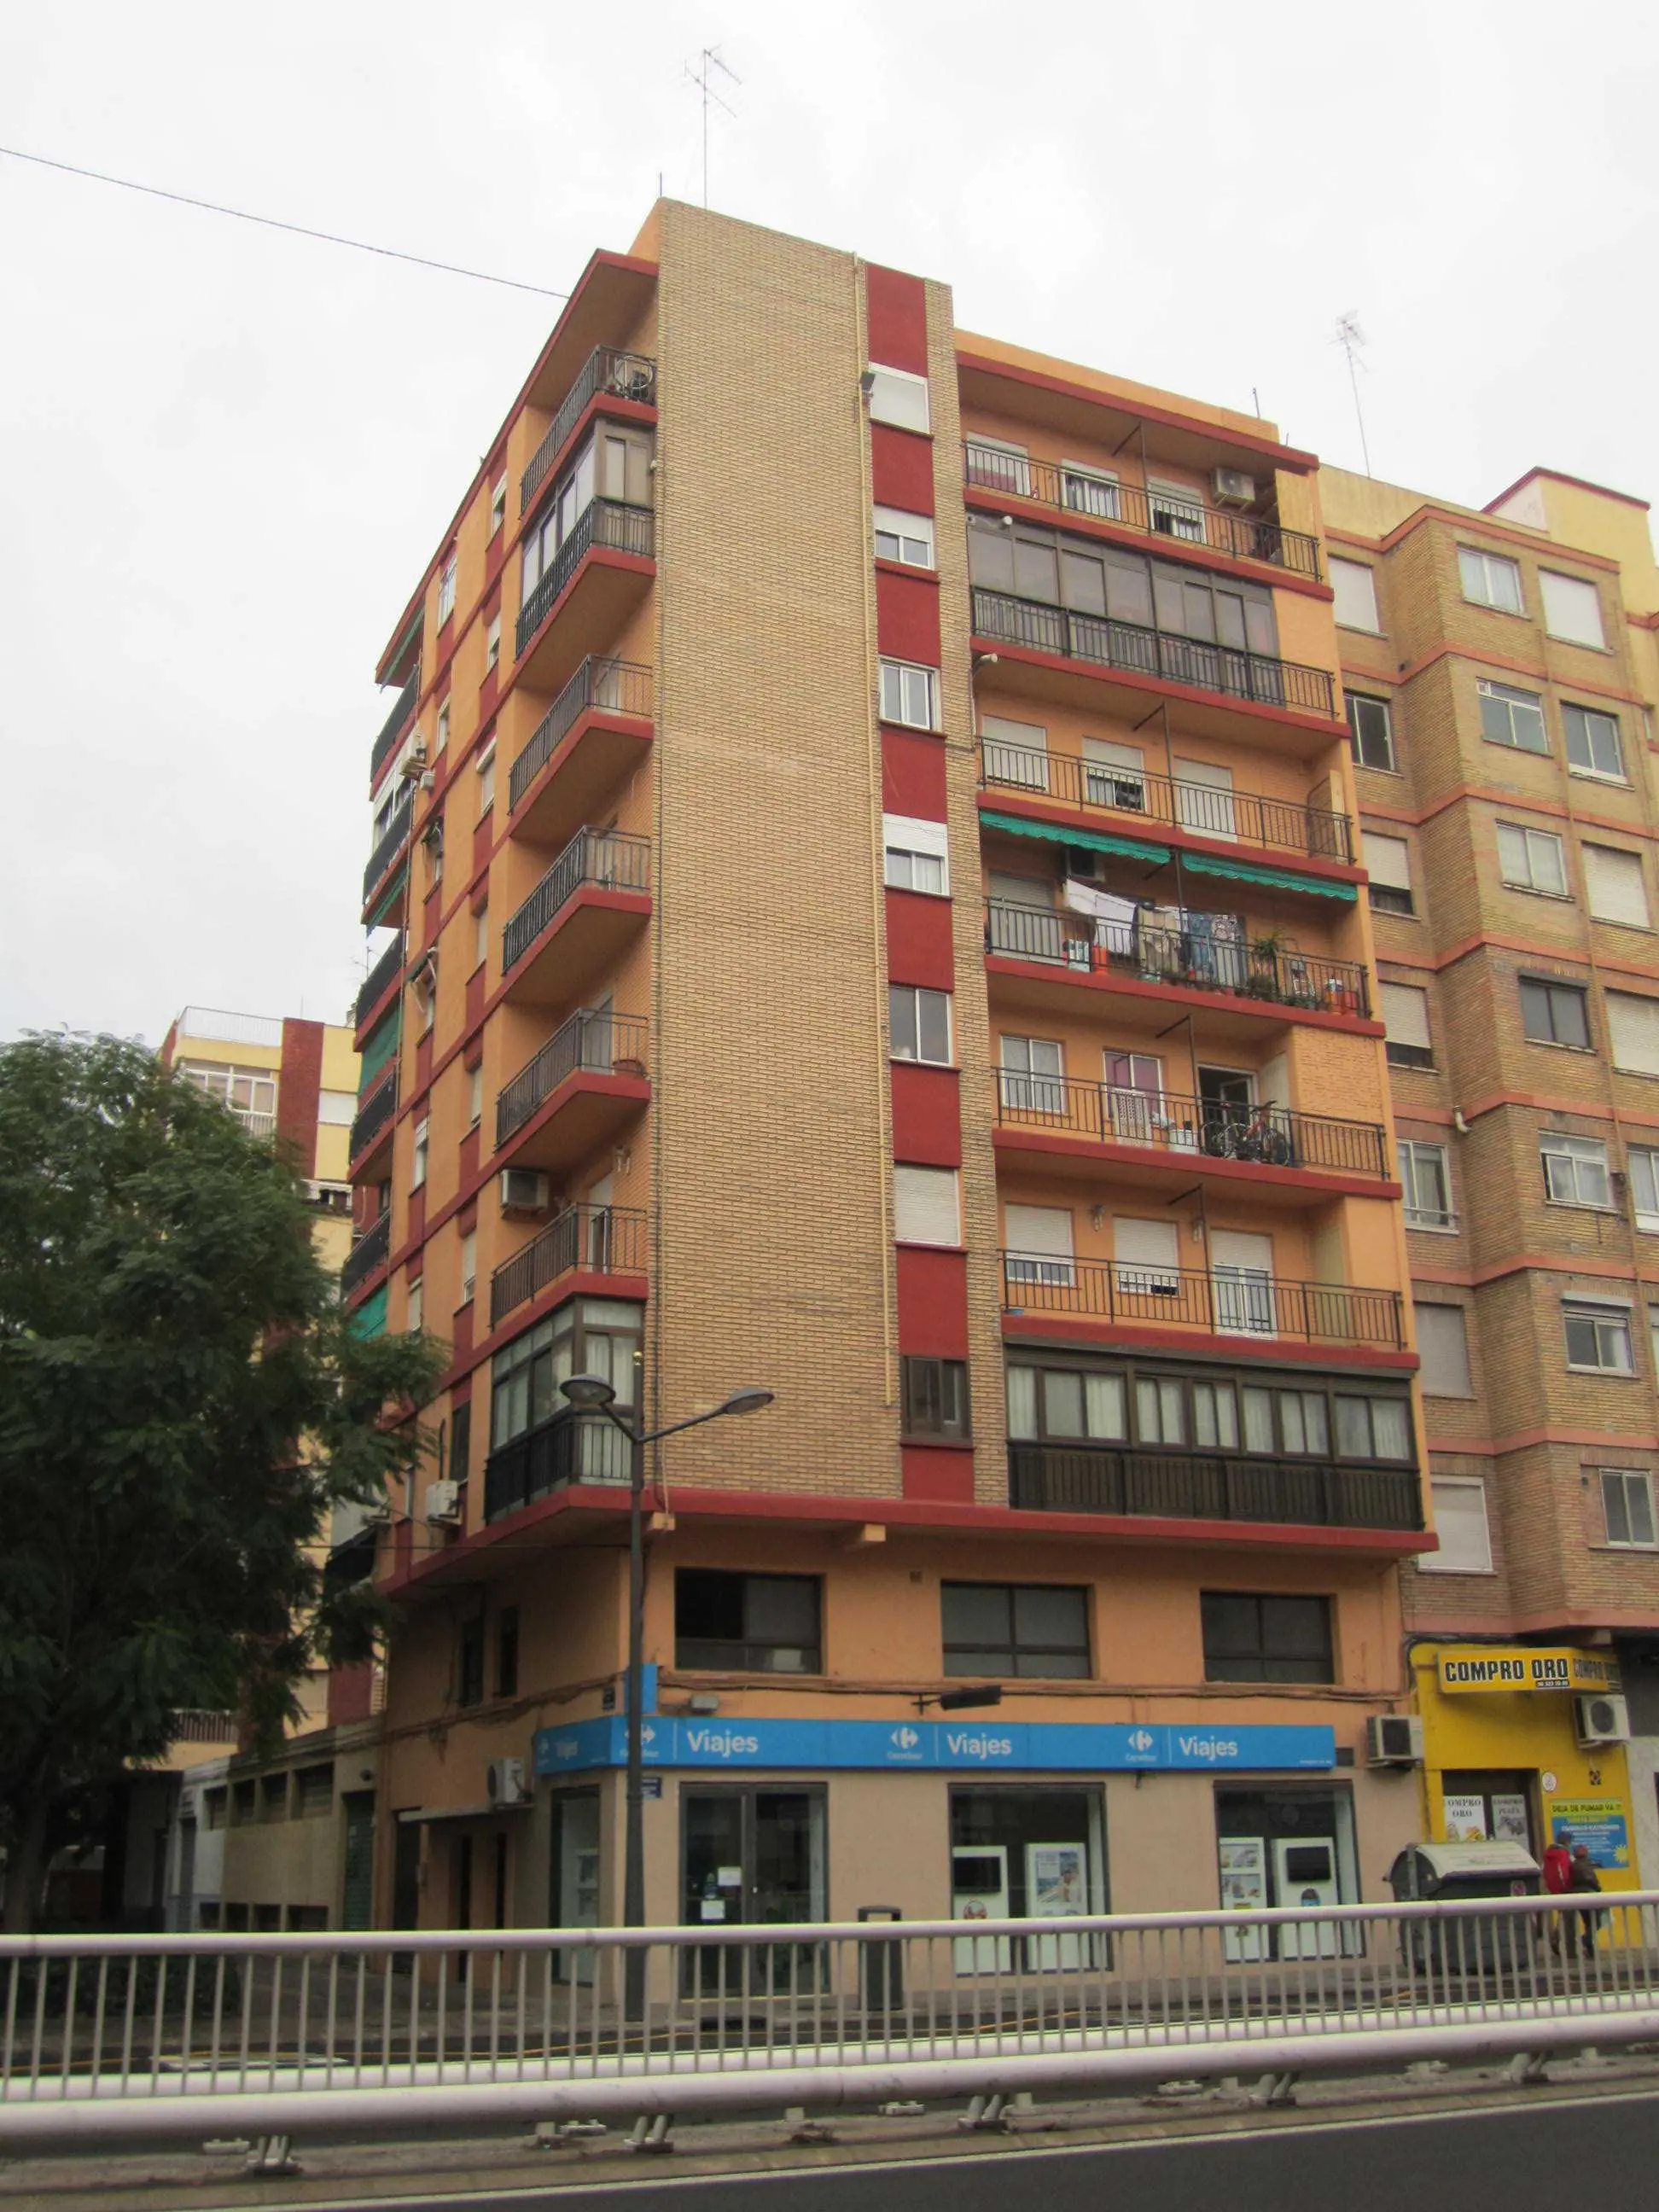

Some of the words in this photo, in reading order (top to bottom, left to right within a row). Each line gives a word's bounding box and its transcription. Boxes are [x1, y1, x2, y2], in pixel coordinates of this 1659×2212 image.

[1445, 1659, 1524, 1682] COMPRO
[1531, 1658, 1569, 1679] ORO
[687, 1729, 759, 1757] Viajes
[946, 1732, 1012, 1760] Viajes
[1179, 1736, 1239, 1761] Viajes
